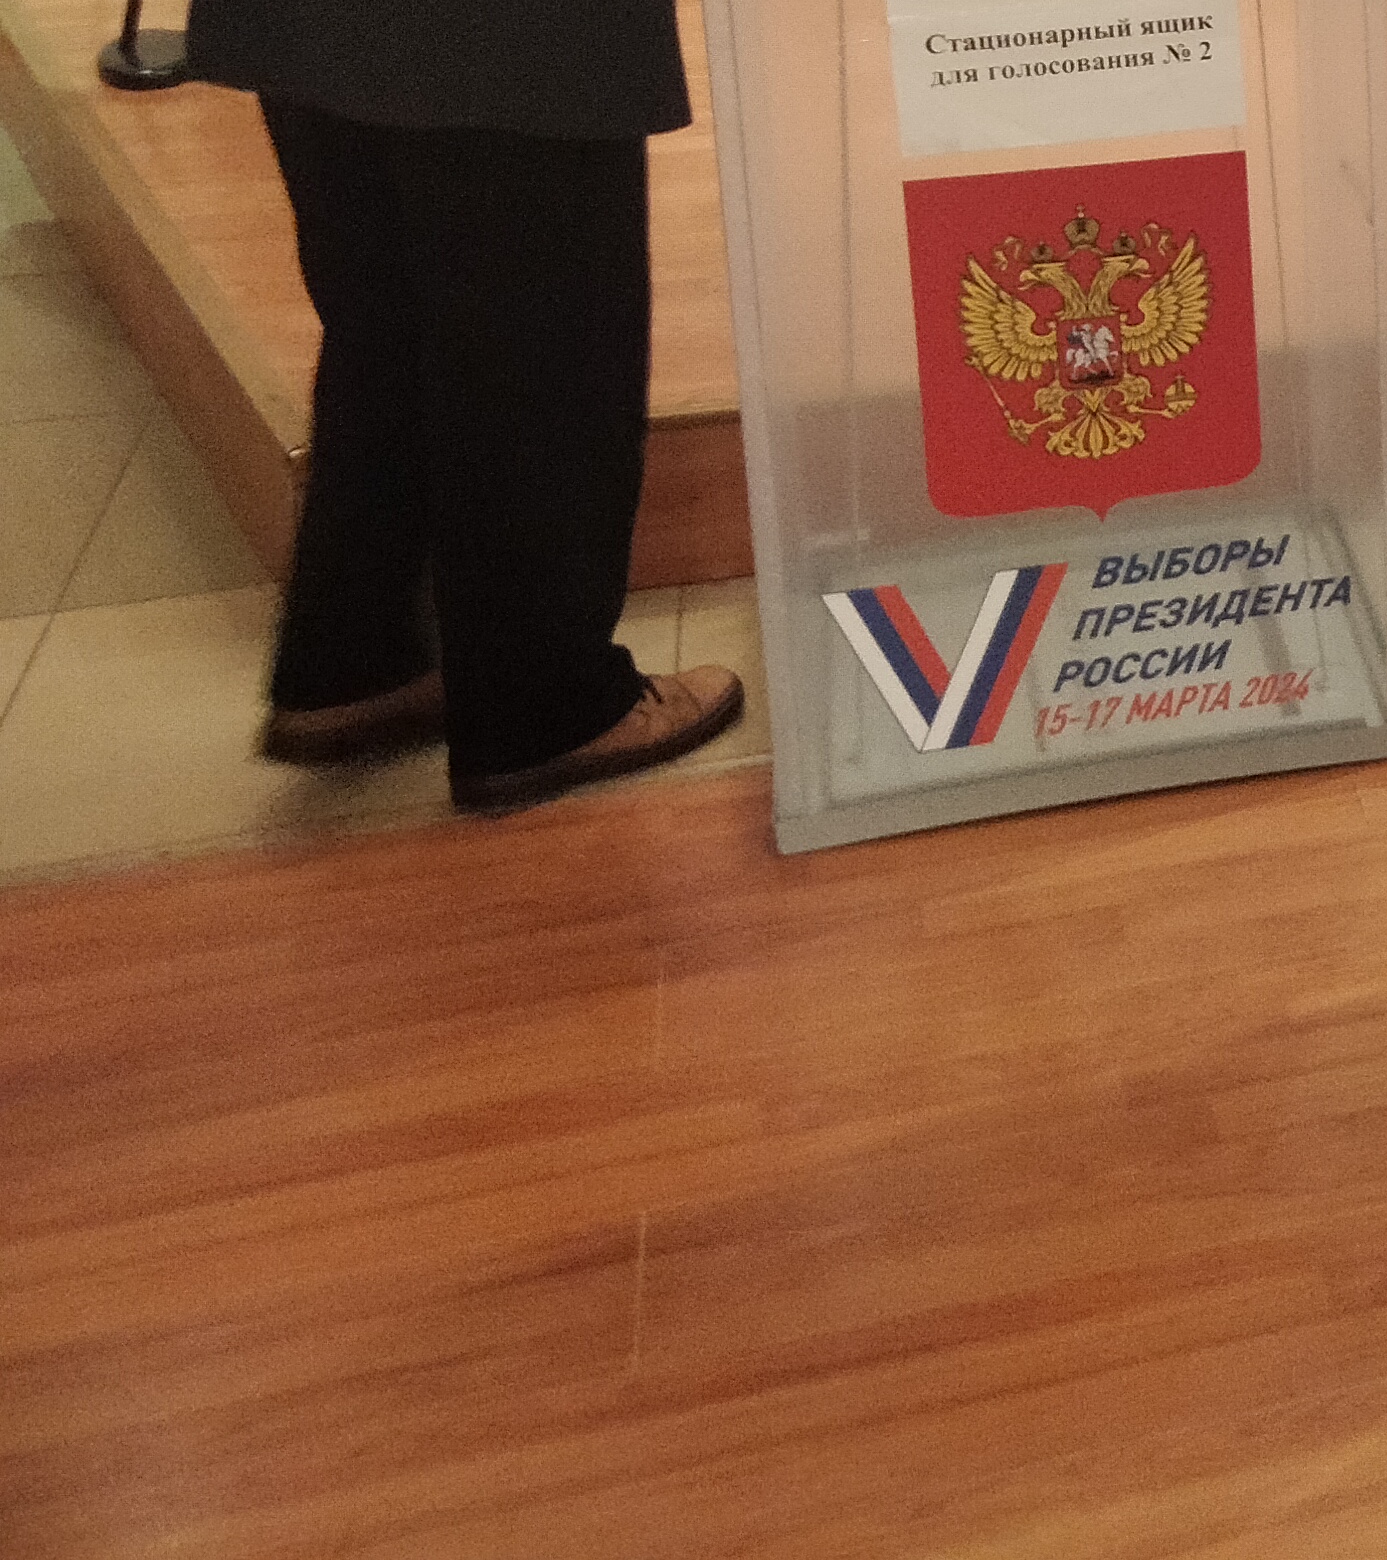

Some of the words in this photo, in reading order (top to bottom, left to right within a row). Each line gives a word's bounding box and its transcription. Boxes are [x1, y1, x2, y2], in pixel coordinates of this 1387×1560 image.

[925, 17, 1132, 55] Стационарный
[1140, 14, 1214, 37] ящик
[930, 65, 979, 88] для
[989, 47, 1155, 81] голосования
[1162, 43, 1191, 65] №
[1199, 40, 1213, 61] 2
[1092, 534, 1290, 589] ВЫБОРЫ
[1072, 575, 1351, 640] ПРЕЗИДЕНТА
[1053, 639, 1232, 693] РОССИИ
[1034, 696, 1123, 738] 15-17
[1125, 681, 1232, 725] МАРТА
[1238, 667, 1315, 708] 2024
